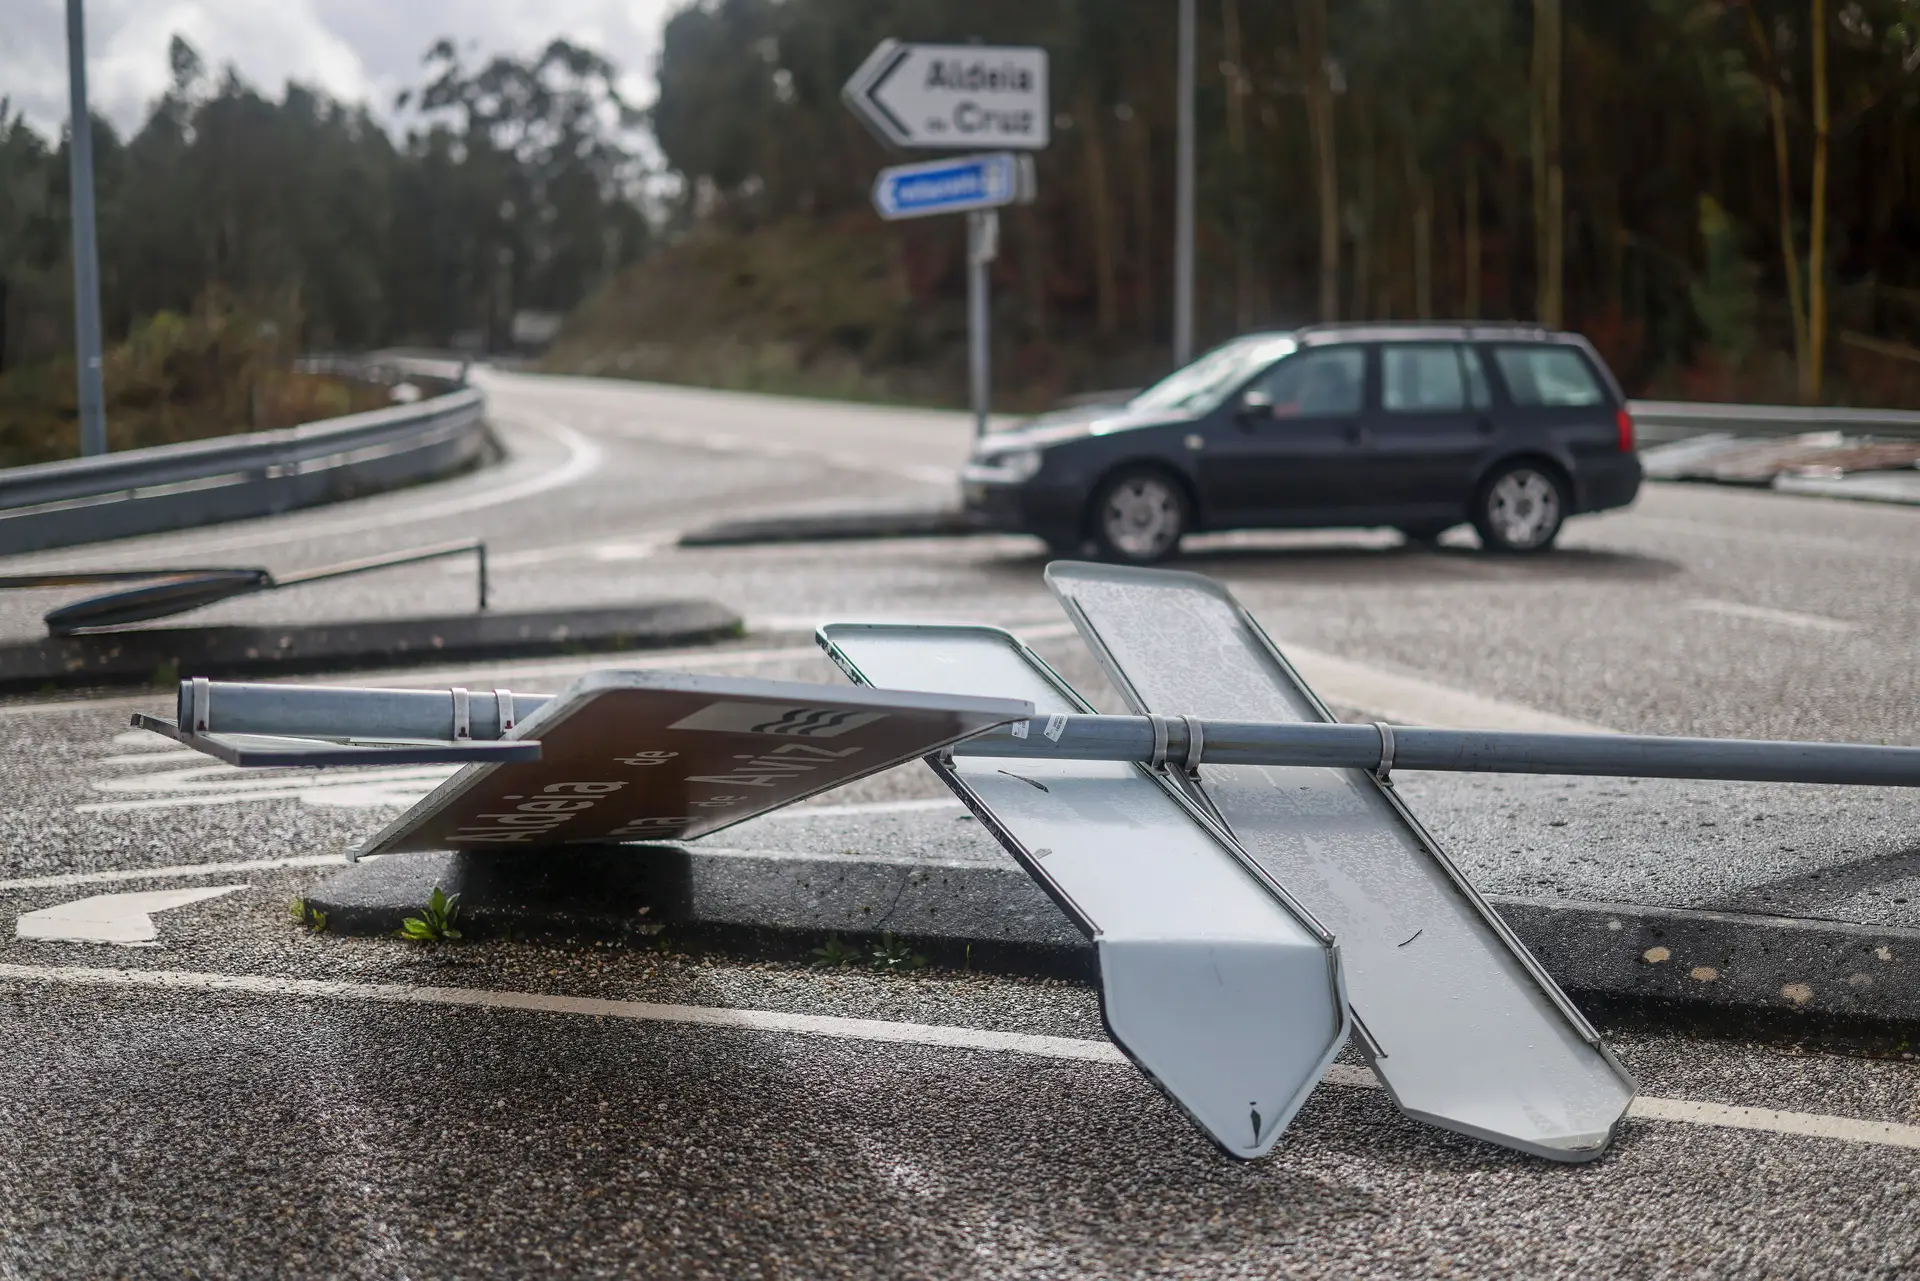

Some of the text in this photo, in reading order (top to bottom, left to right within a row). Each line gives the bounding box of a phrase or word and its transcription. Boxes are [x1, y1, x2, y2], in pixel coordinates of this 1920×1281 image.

[924, 60, 1034, 92] Aldeia
[954, 100, 1034, 134] Cruz
[684, 743, 864, 787] Aviz
[445, 750, 679, 842] Aldeia de
[690, 795, 747, 807] de
